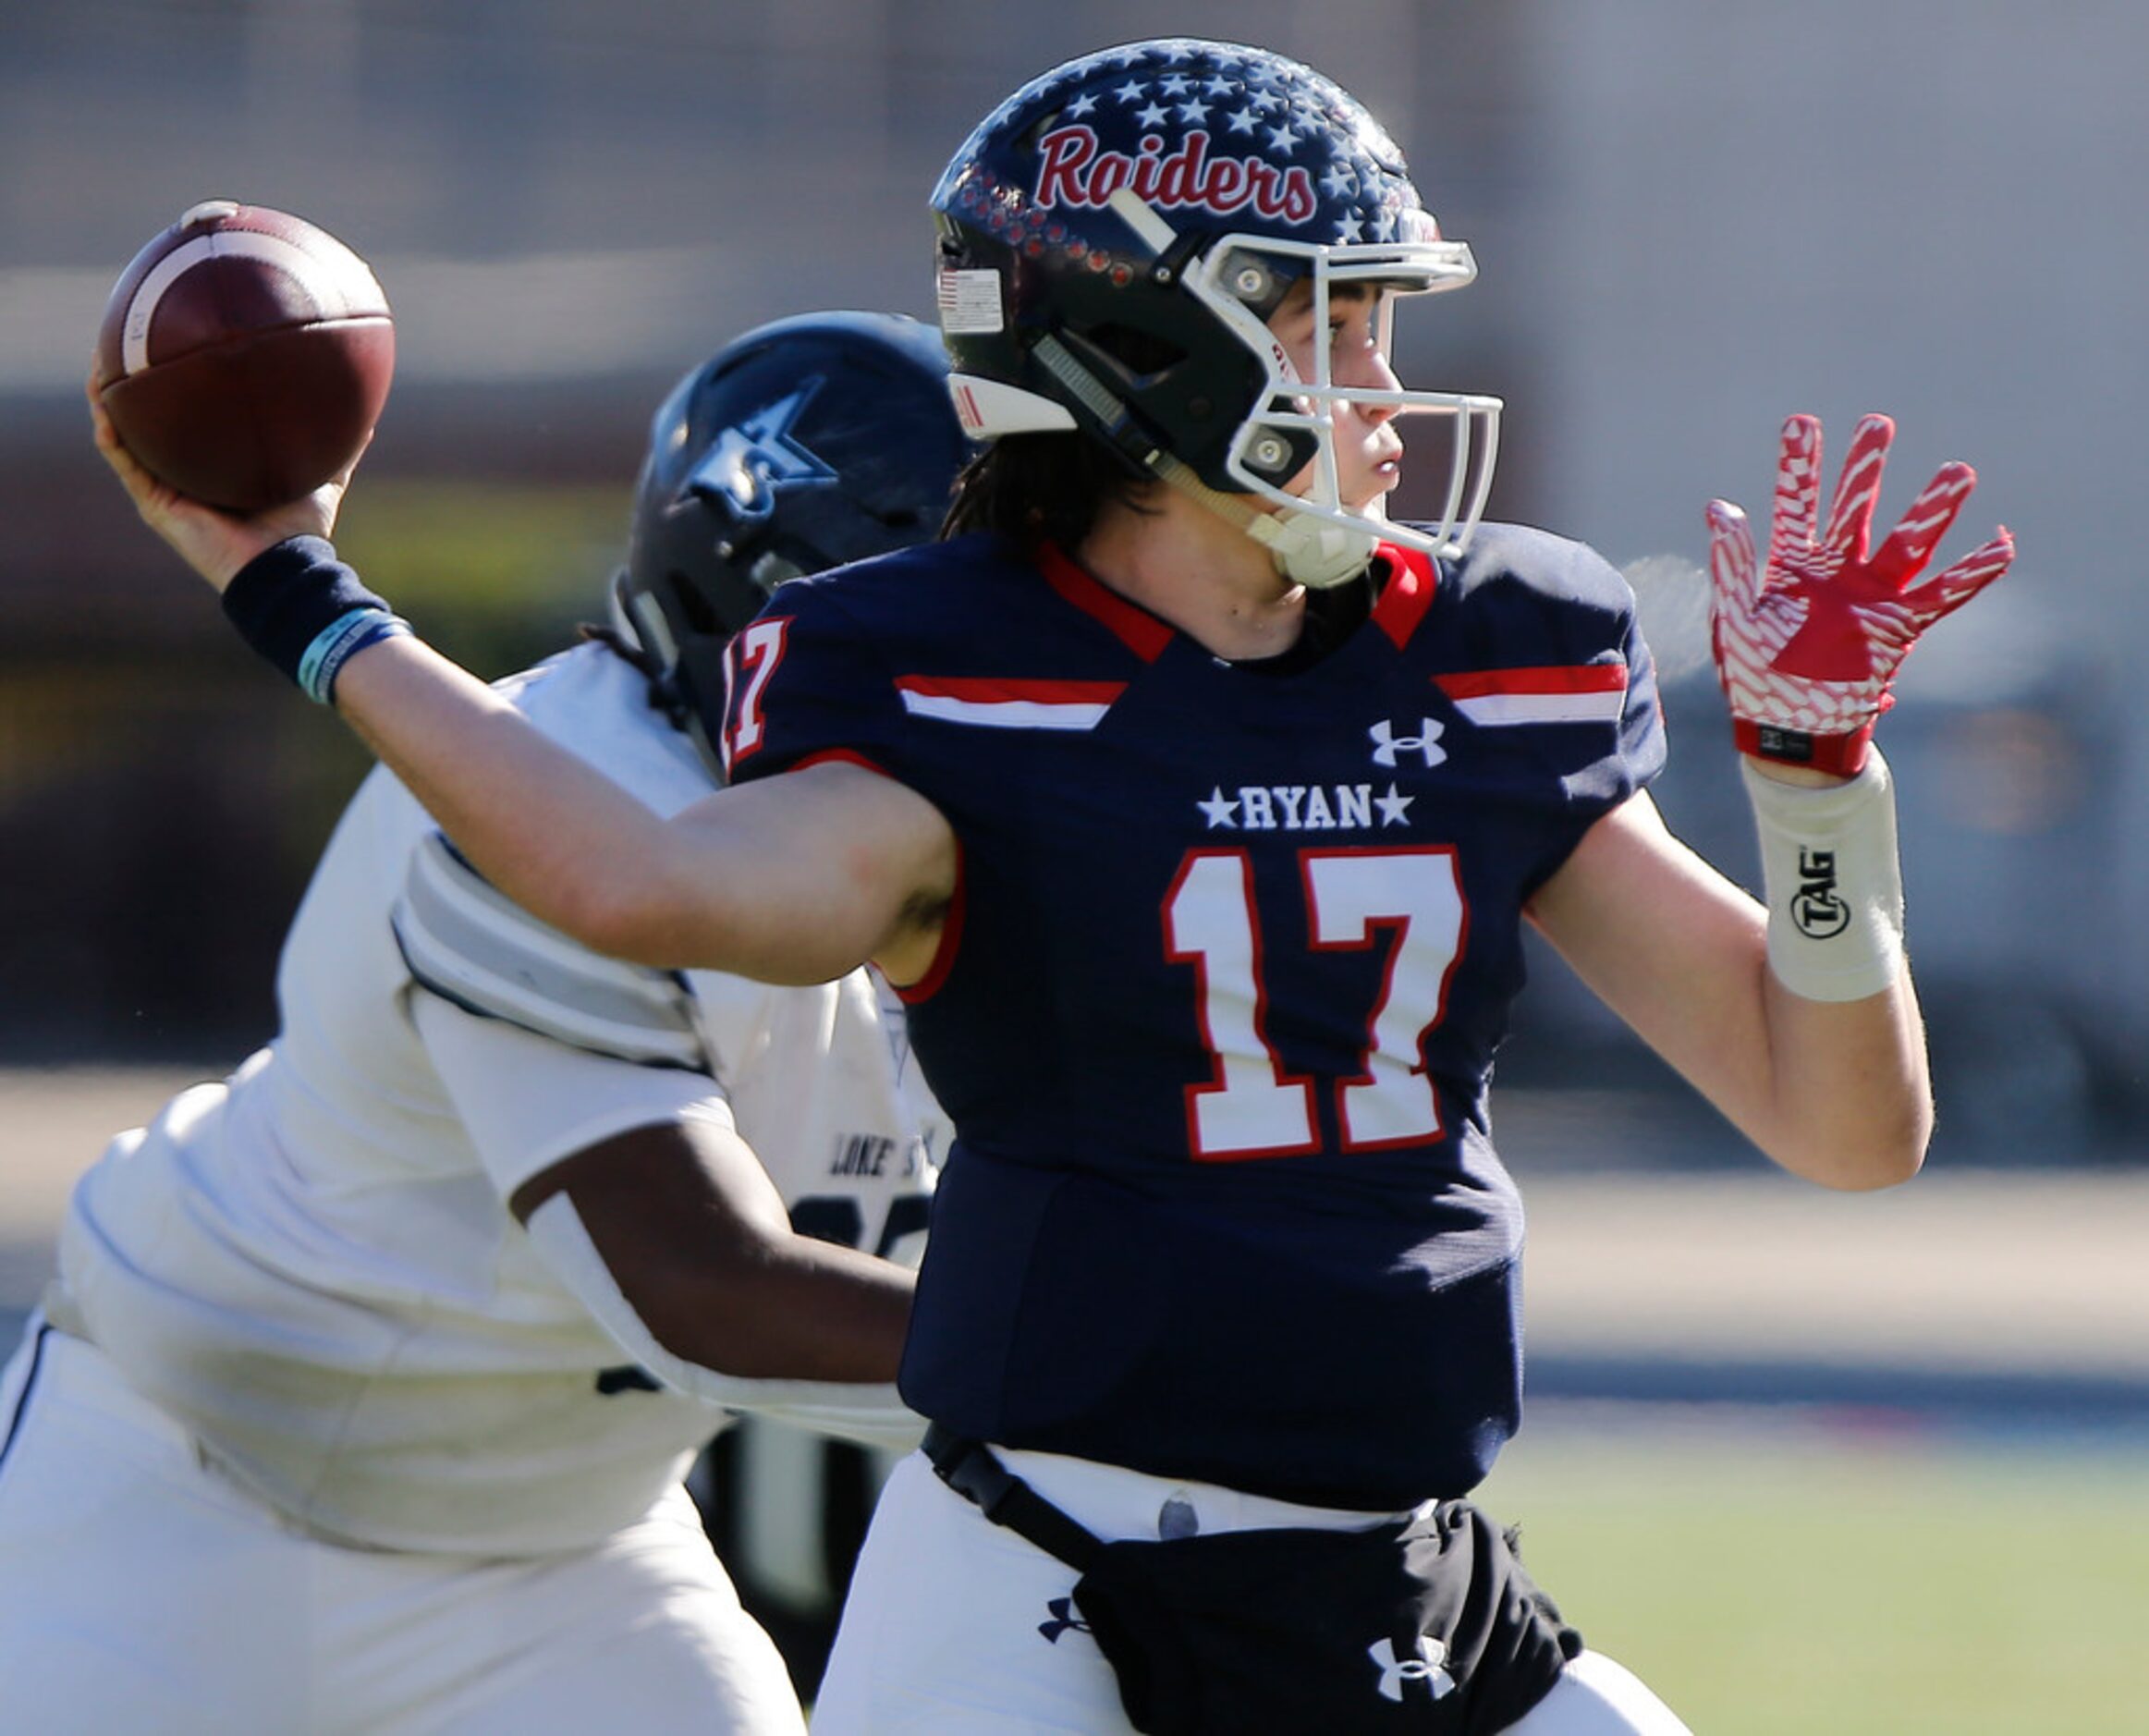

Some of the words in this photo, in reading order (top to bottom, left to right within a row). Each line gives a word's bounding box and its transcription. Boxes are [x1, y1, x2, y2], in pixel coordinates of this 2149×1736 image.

[1036, 124, 1316, 225] Raiders
[1239, 784, 1373, 829] RYAN
[1798, 845, 1840, 928] TAG
[1160, 843, 1471, 1162] 17
